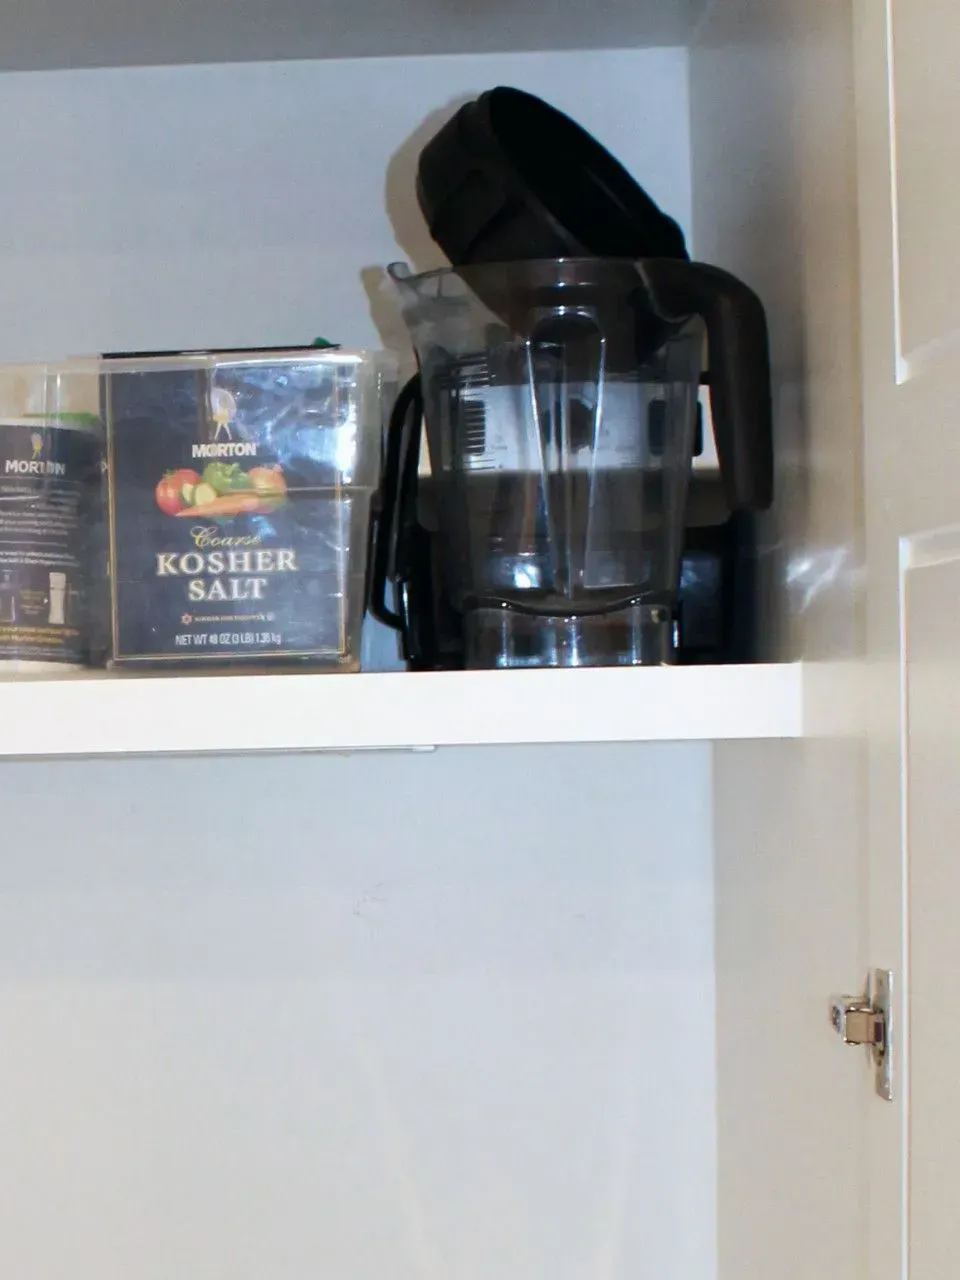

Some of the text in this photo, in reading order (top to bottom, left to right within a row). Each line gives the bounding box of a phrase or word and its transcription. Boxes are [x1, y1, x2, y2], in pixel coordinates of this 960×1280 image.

[191, 442, 257, 458] MORTON
[190, 525, 262, 549] Coarse
[156, 548, 298, 576] KOSHER
[188, 578, 268, 601] SALT
[174, 634, 191, 646] NET
[193, 634, 207, 645] WT
[219, 633, 231, 645] OZ
